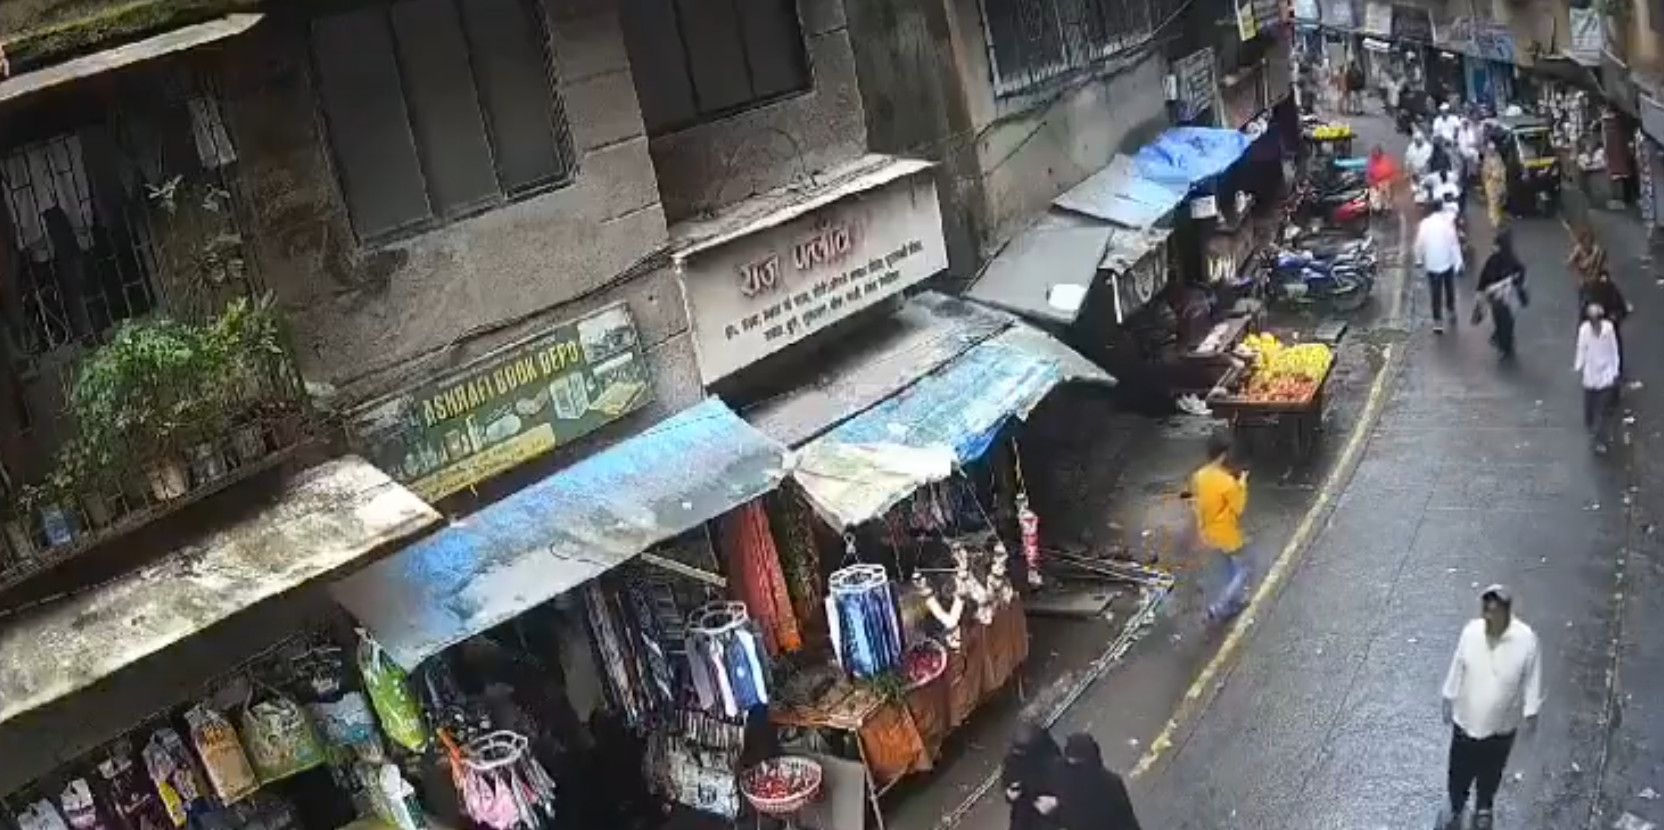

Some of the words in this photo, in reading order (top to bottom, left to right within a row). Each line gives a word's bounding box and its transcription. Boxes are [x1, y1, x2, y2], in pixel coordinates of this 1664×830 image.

[740, 250, 780, 298] राज
[422, 374, 495, 428] ASHRAFI
[493, 356, 538, 395] BOOK
[538, 340, 579, 375] DEPO
